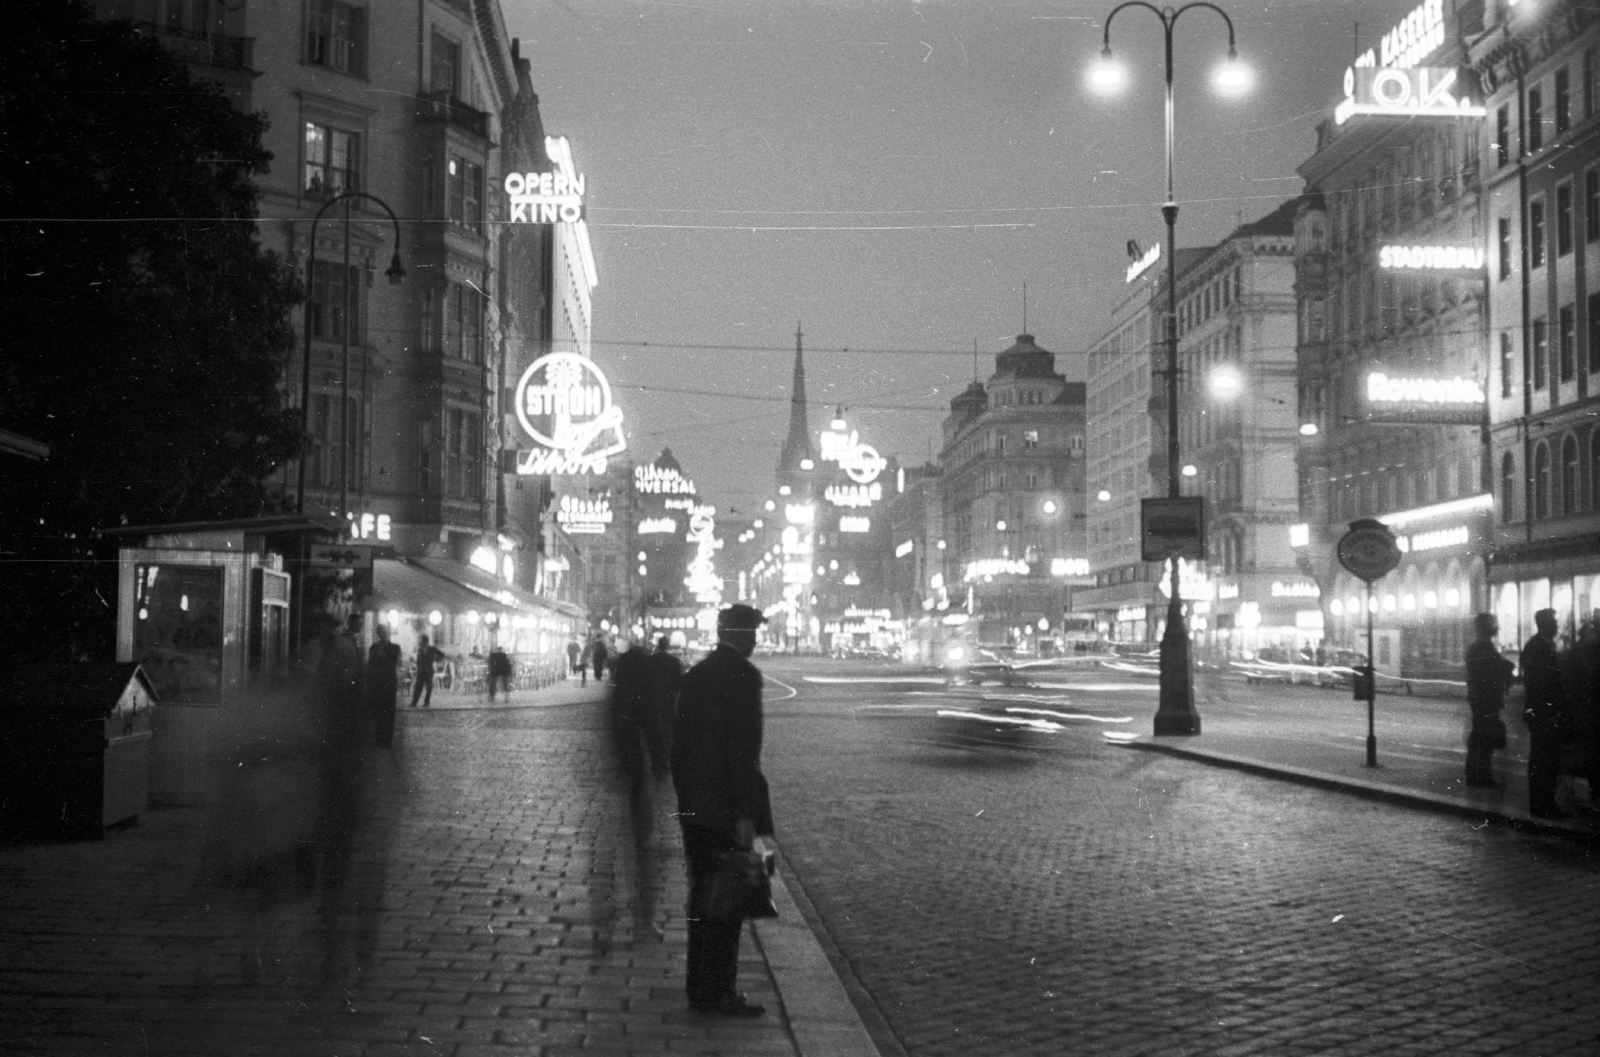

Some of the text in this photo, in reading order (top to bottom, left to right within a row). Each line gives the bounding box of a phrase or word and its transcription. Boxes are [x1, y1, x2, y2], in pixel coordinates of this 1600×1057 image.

[1373, 68, 1470, 108] O.K.
[505, 172, 585, 196] OPERN
[510, 203, 581, 223] KINO
[527, 385, 602, 416] STROH
